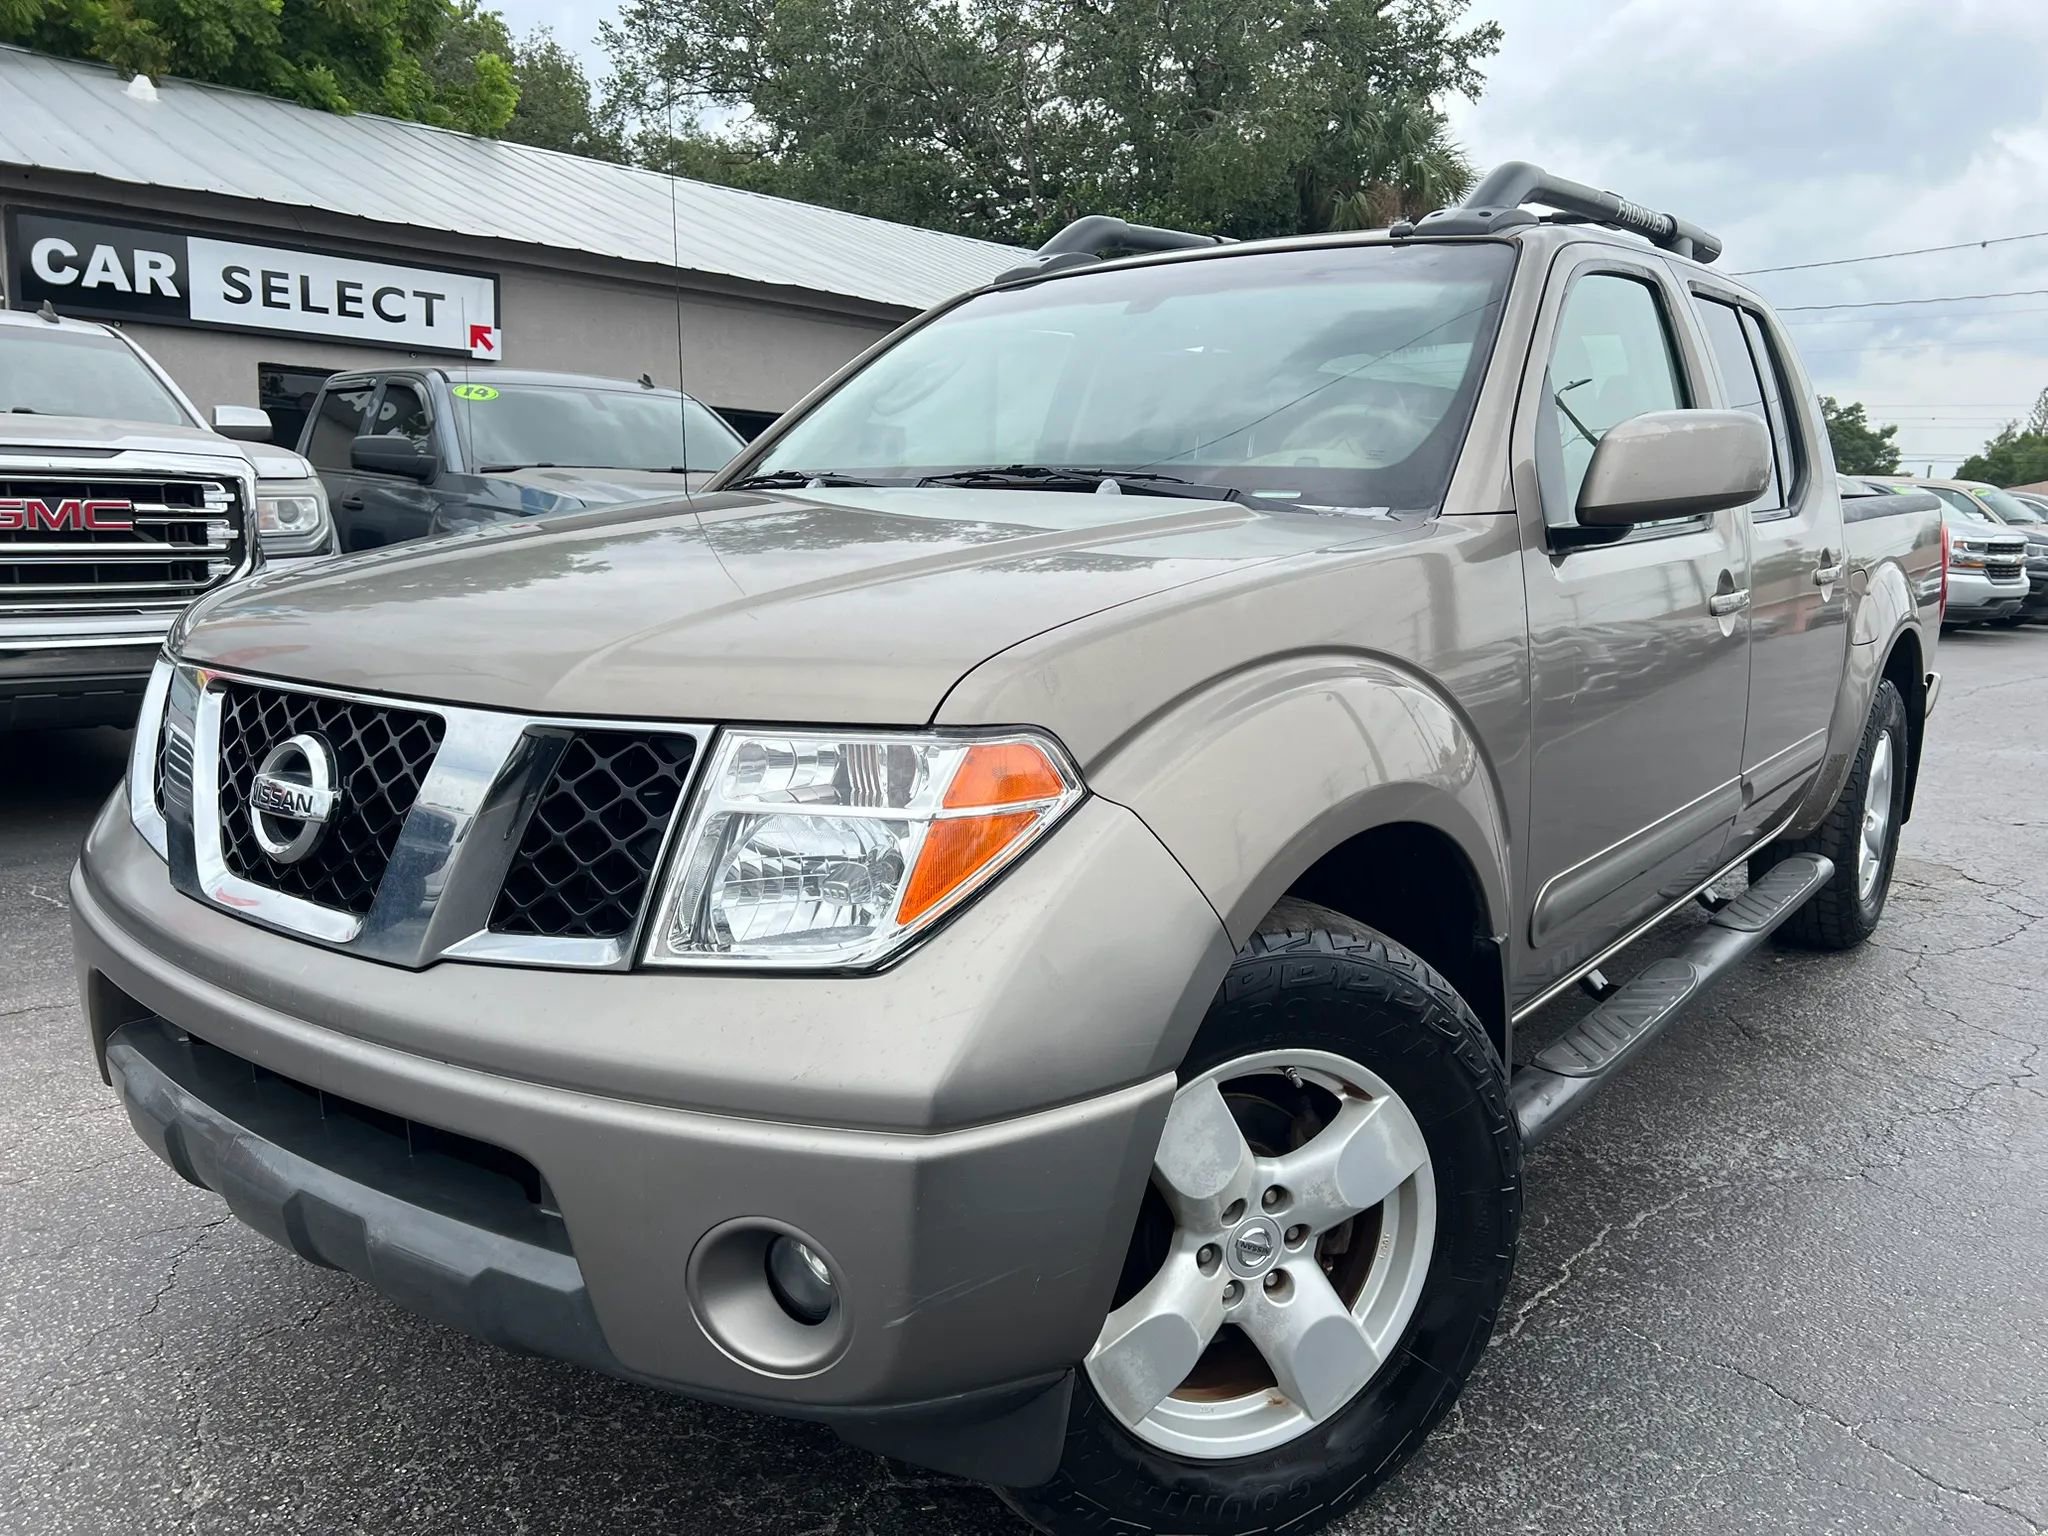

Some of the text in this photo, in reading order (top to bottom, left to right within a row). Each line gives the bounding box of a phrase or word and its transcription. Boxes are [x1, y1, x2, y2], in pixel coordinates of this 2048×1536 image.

[1616, 200, 1668, 234] FRONTIER
[30, 236, 446, 327] CAR SELECT
[252, 780, 314, 814] NISSAN
